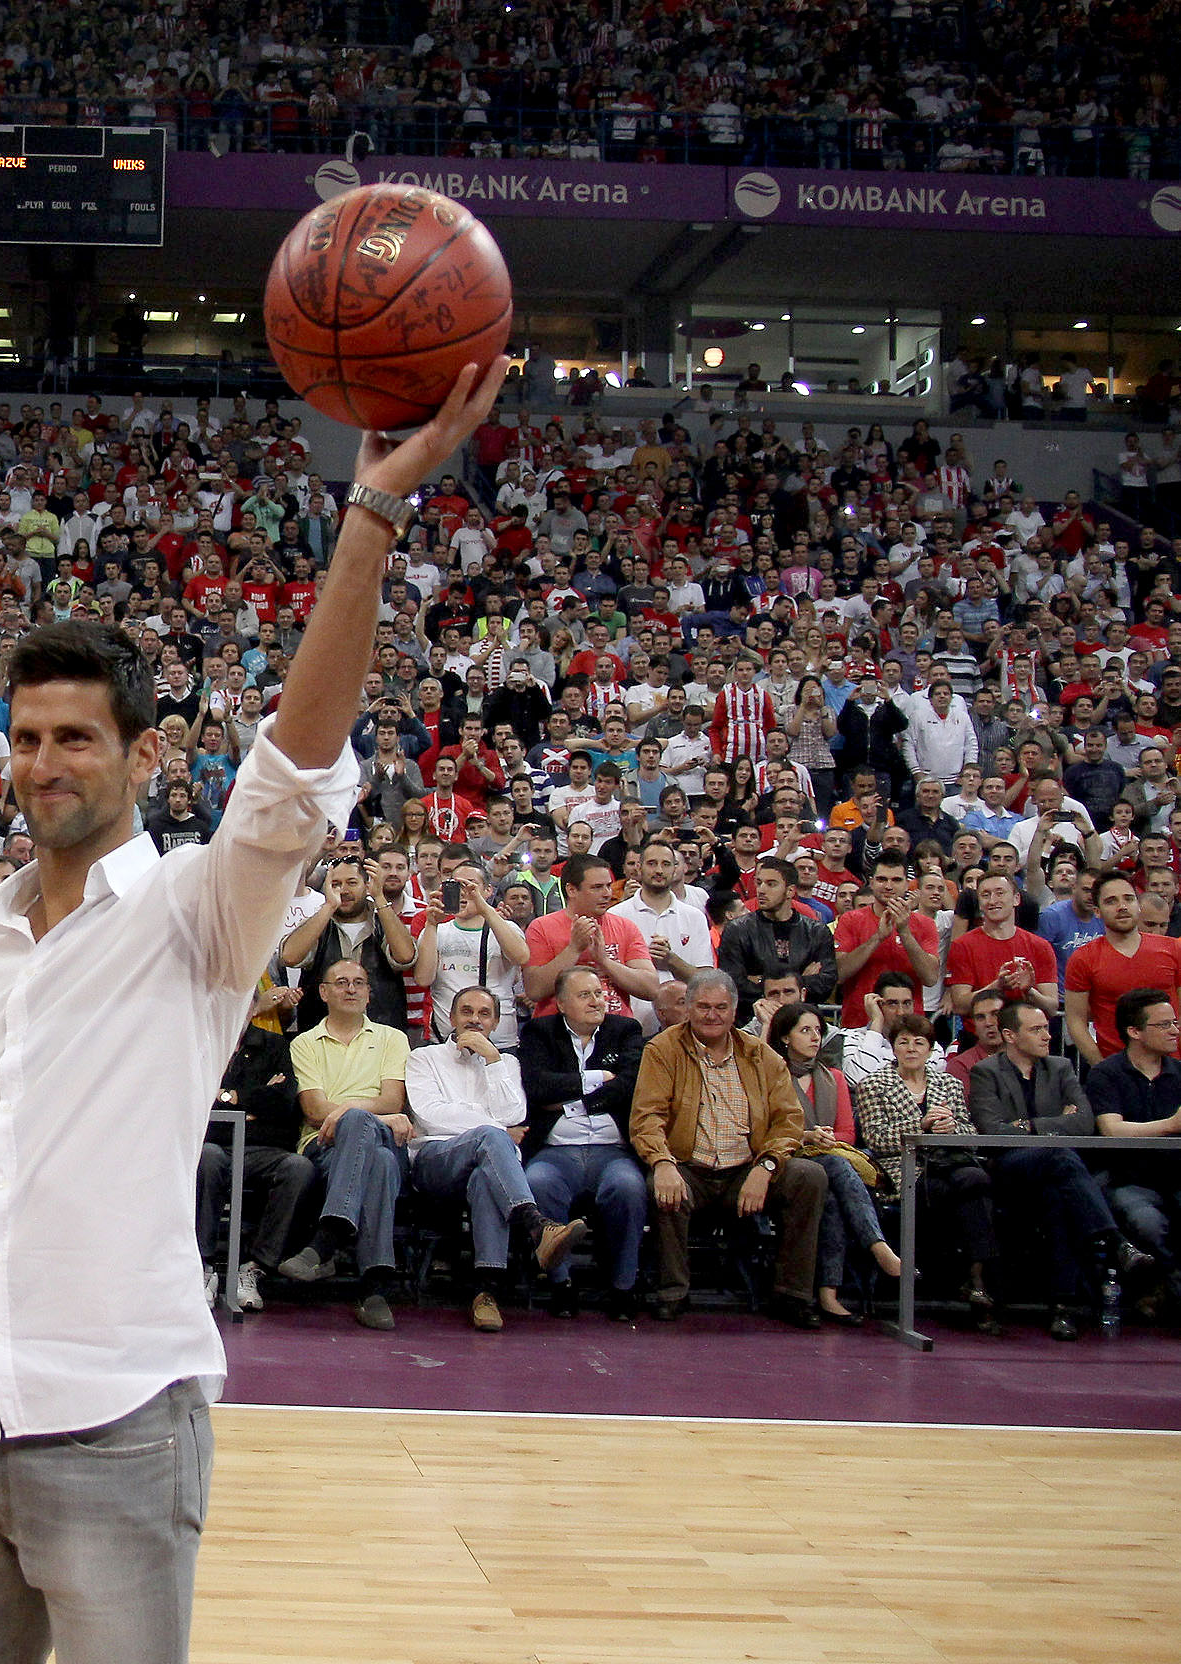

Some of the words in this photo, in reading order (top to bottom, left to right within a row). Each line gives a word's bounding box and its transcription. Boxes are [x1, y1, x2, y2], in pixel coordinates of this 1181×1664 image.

[48, 164, 77, 173] PERIOD
[113, 159, 146, 171] UNIKS
[537, 175, 628, 204] Arena
[130, 202, 156, 212] FOULS
[798, 184, 948, 214] KOMBANK
[955, 190, 1047, 217] Arena
[357, 197, 427, 266] DING
